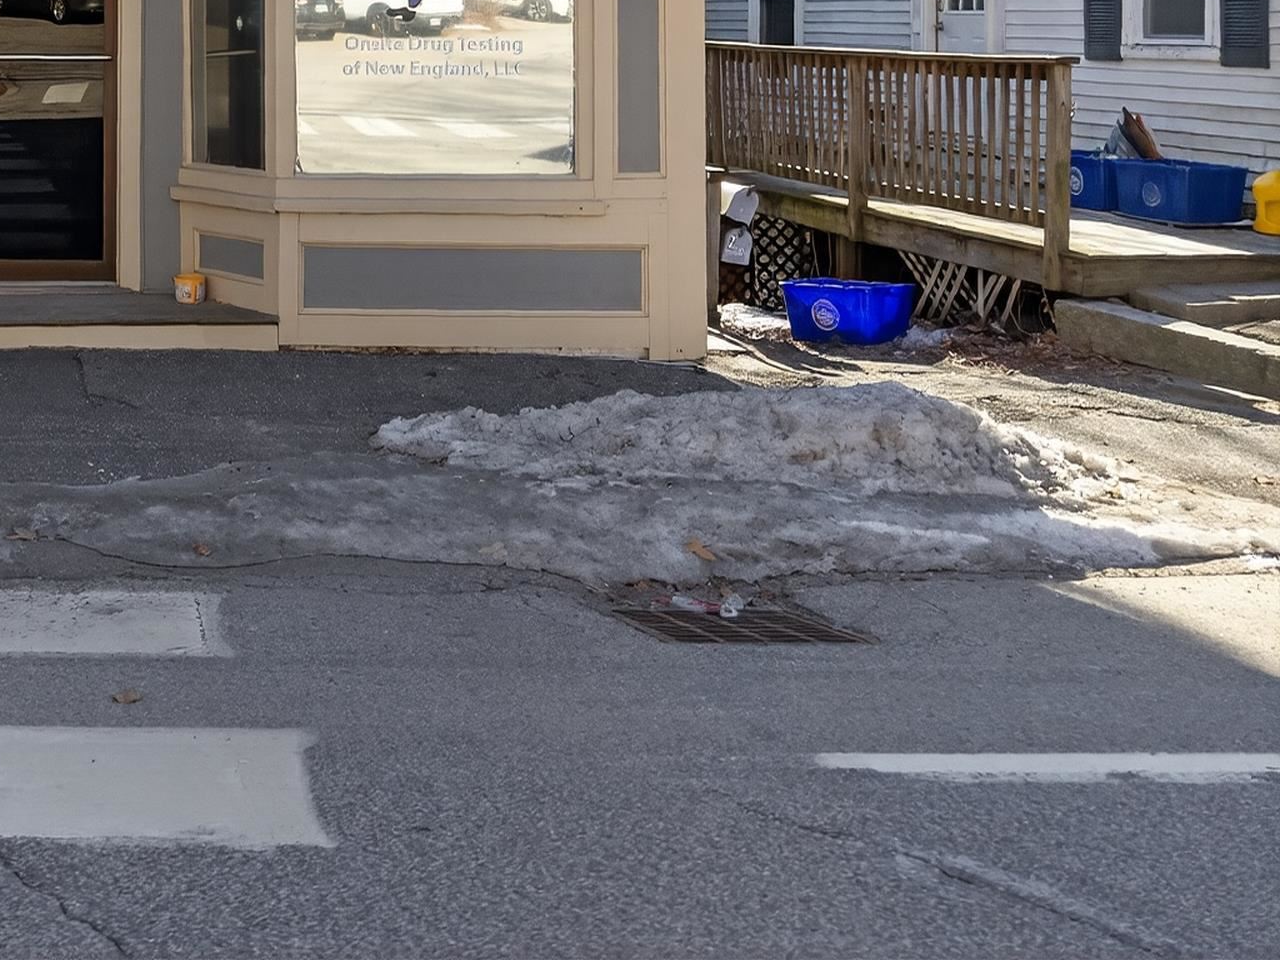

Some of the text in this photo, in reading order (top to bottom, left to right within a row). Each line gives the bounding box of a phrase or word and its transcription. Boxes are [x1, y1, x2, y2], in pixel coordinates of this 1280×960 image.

[345, 36, 524, 55] Onsite Drug Testing
[342, 60, 525, 79] of New England, LLC
